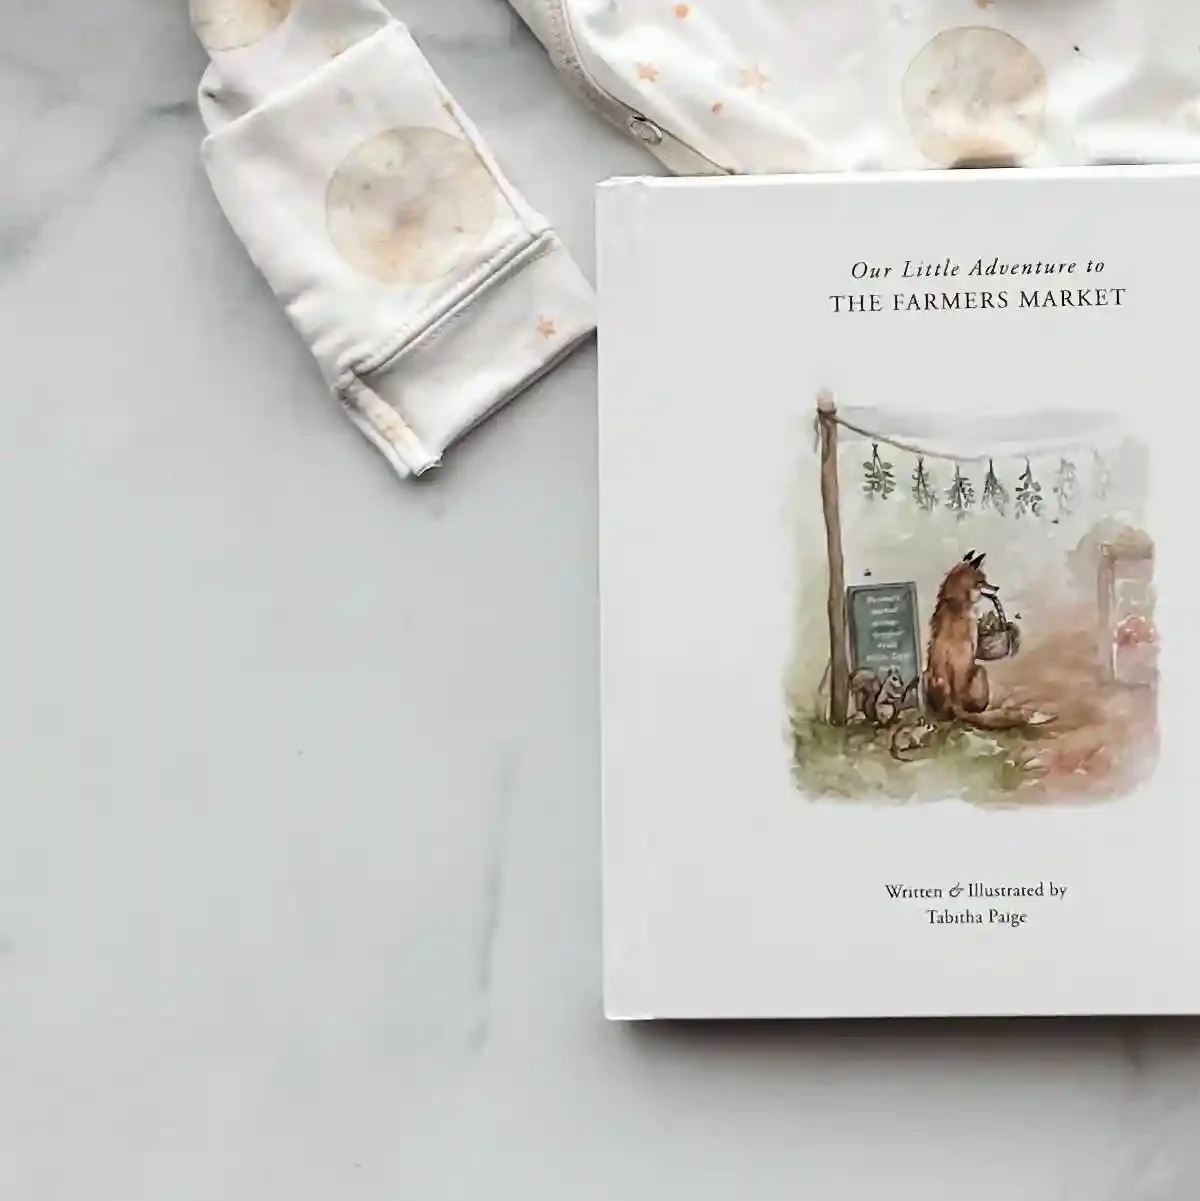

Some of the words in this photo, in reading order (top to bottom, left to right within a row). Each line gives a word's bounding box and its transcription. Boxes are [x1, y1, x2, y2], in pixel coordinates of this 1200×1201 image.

[850, 260, 893, 280] Our
[900, 257, 960, 279] Little
[968, 256, 1077, 277] Adventure
[1086, 259, 1106, 274] to
[829, 294, 884, 313] THE
[892, 290, 1009, 311] FARMERS
[1018, 288, 1127, 309] MARKET
[884, 883, 944, 899] Written
[948, 881, 965, 899] &
[967, 880, 1045, 898] Illustrated
[1049, 880, 1068, 901] by
[926, 908, 983, 925] Tabitha
[988, 907, 1028, 928] Paige
